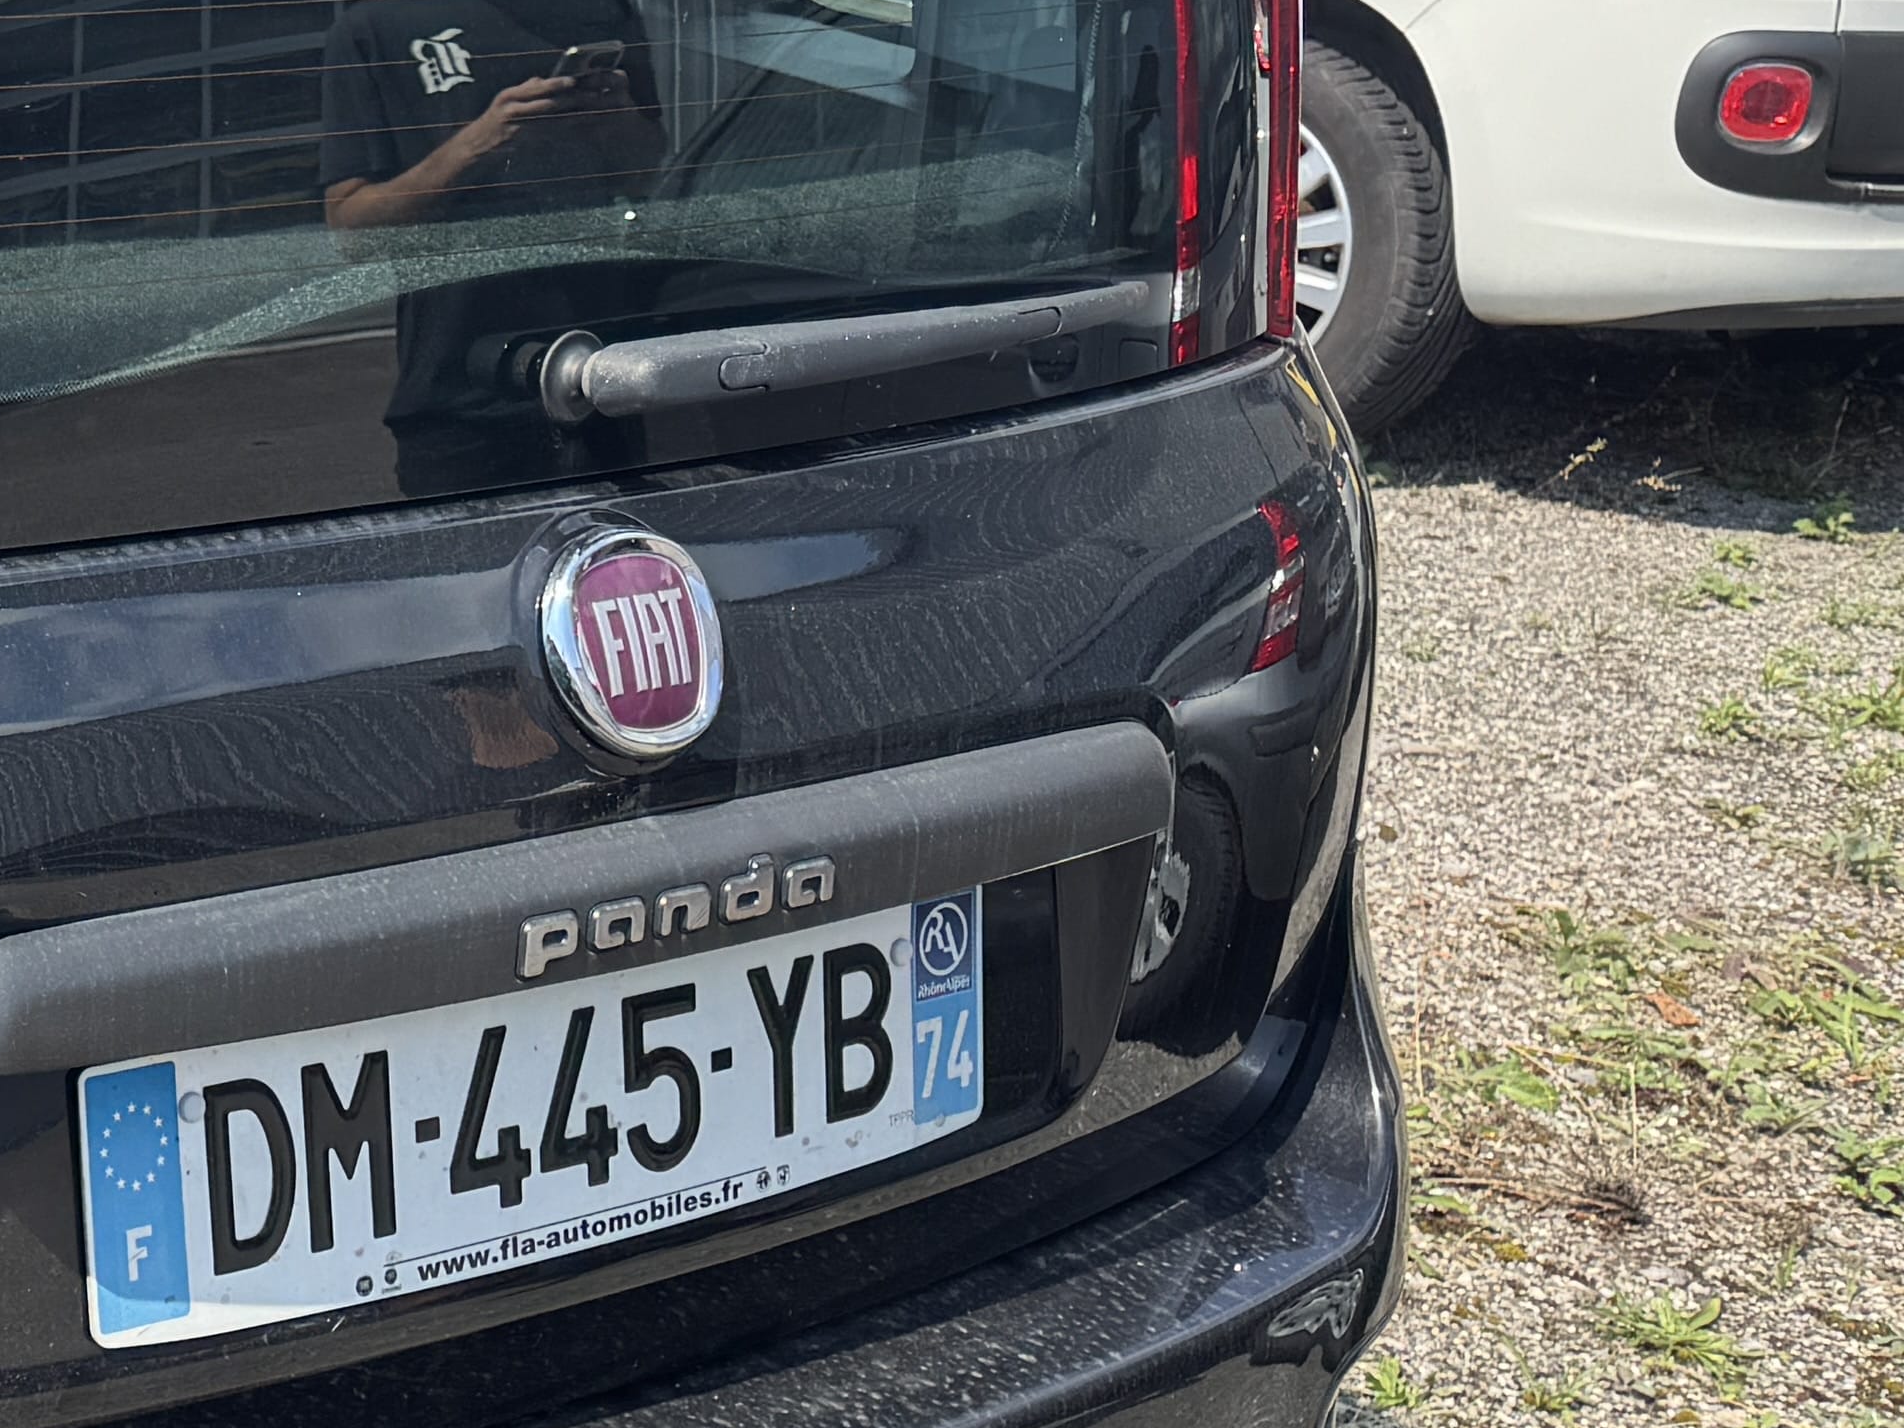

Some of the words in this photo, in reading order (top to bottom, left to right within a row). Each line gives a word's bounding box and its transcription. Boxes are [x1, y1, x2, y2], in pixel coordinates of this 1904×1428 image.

[592, 587, 693, 699] FIAT
[517, 852, 836, 982] panda
[916, 1009, 974, 1099] 74
[203, 942, 894, 1276] DM-445-YB
[125, 1224, 152, 1282] F
[417, 1178, 744, 1282] www.fla-automobiles.fr
